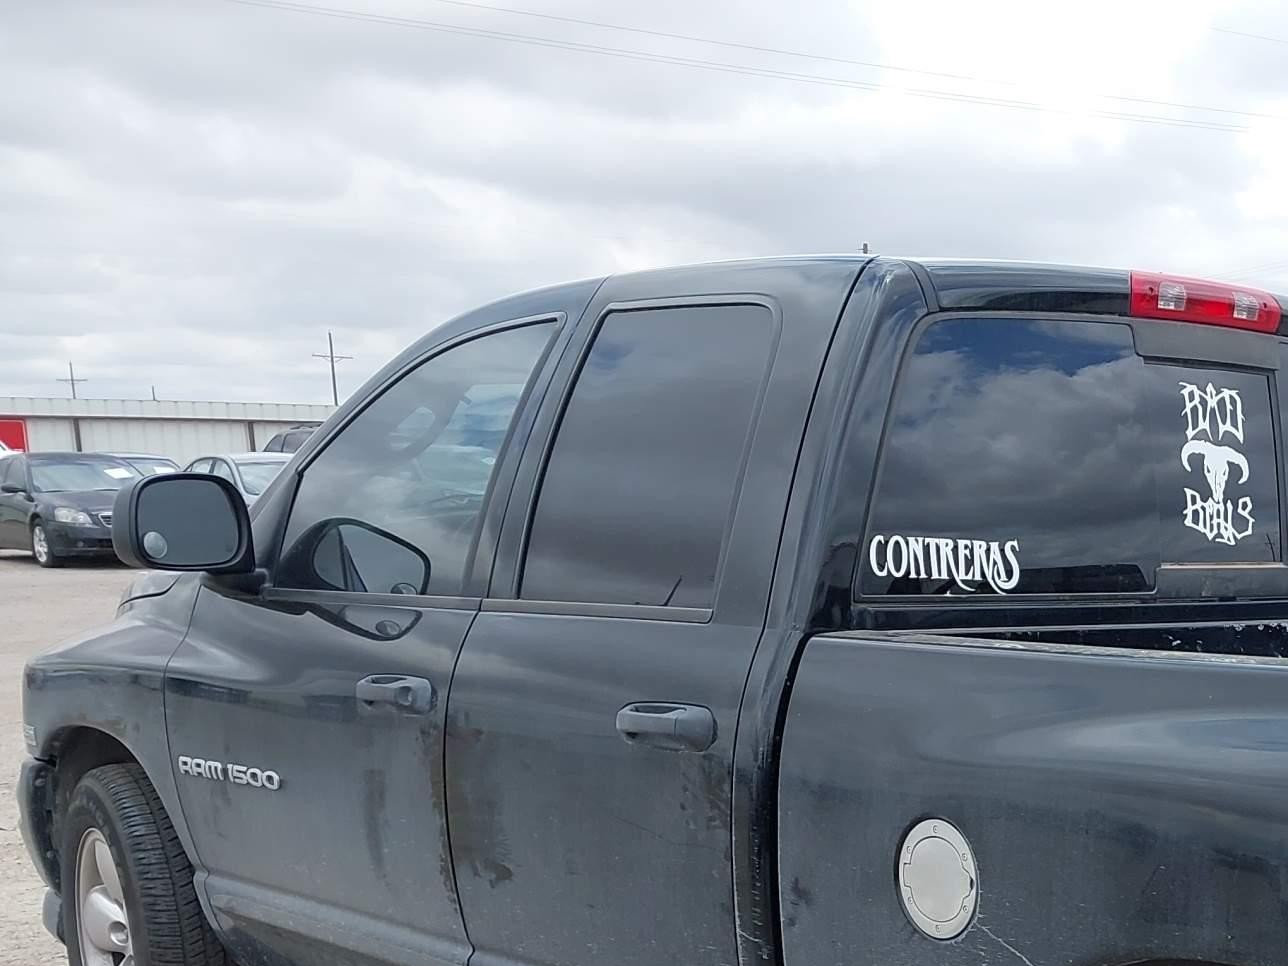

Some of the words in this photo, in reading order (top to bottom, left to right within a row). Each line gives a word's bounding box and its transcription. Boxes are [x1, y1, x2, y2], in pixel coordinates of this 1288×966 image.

[1178, 381, 1246, 444] BAD
[869, 534, 1021, 595] CONTRERAS
[178, 755, 225, 781] RAM
[226, 763, 281, 791] 1500
